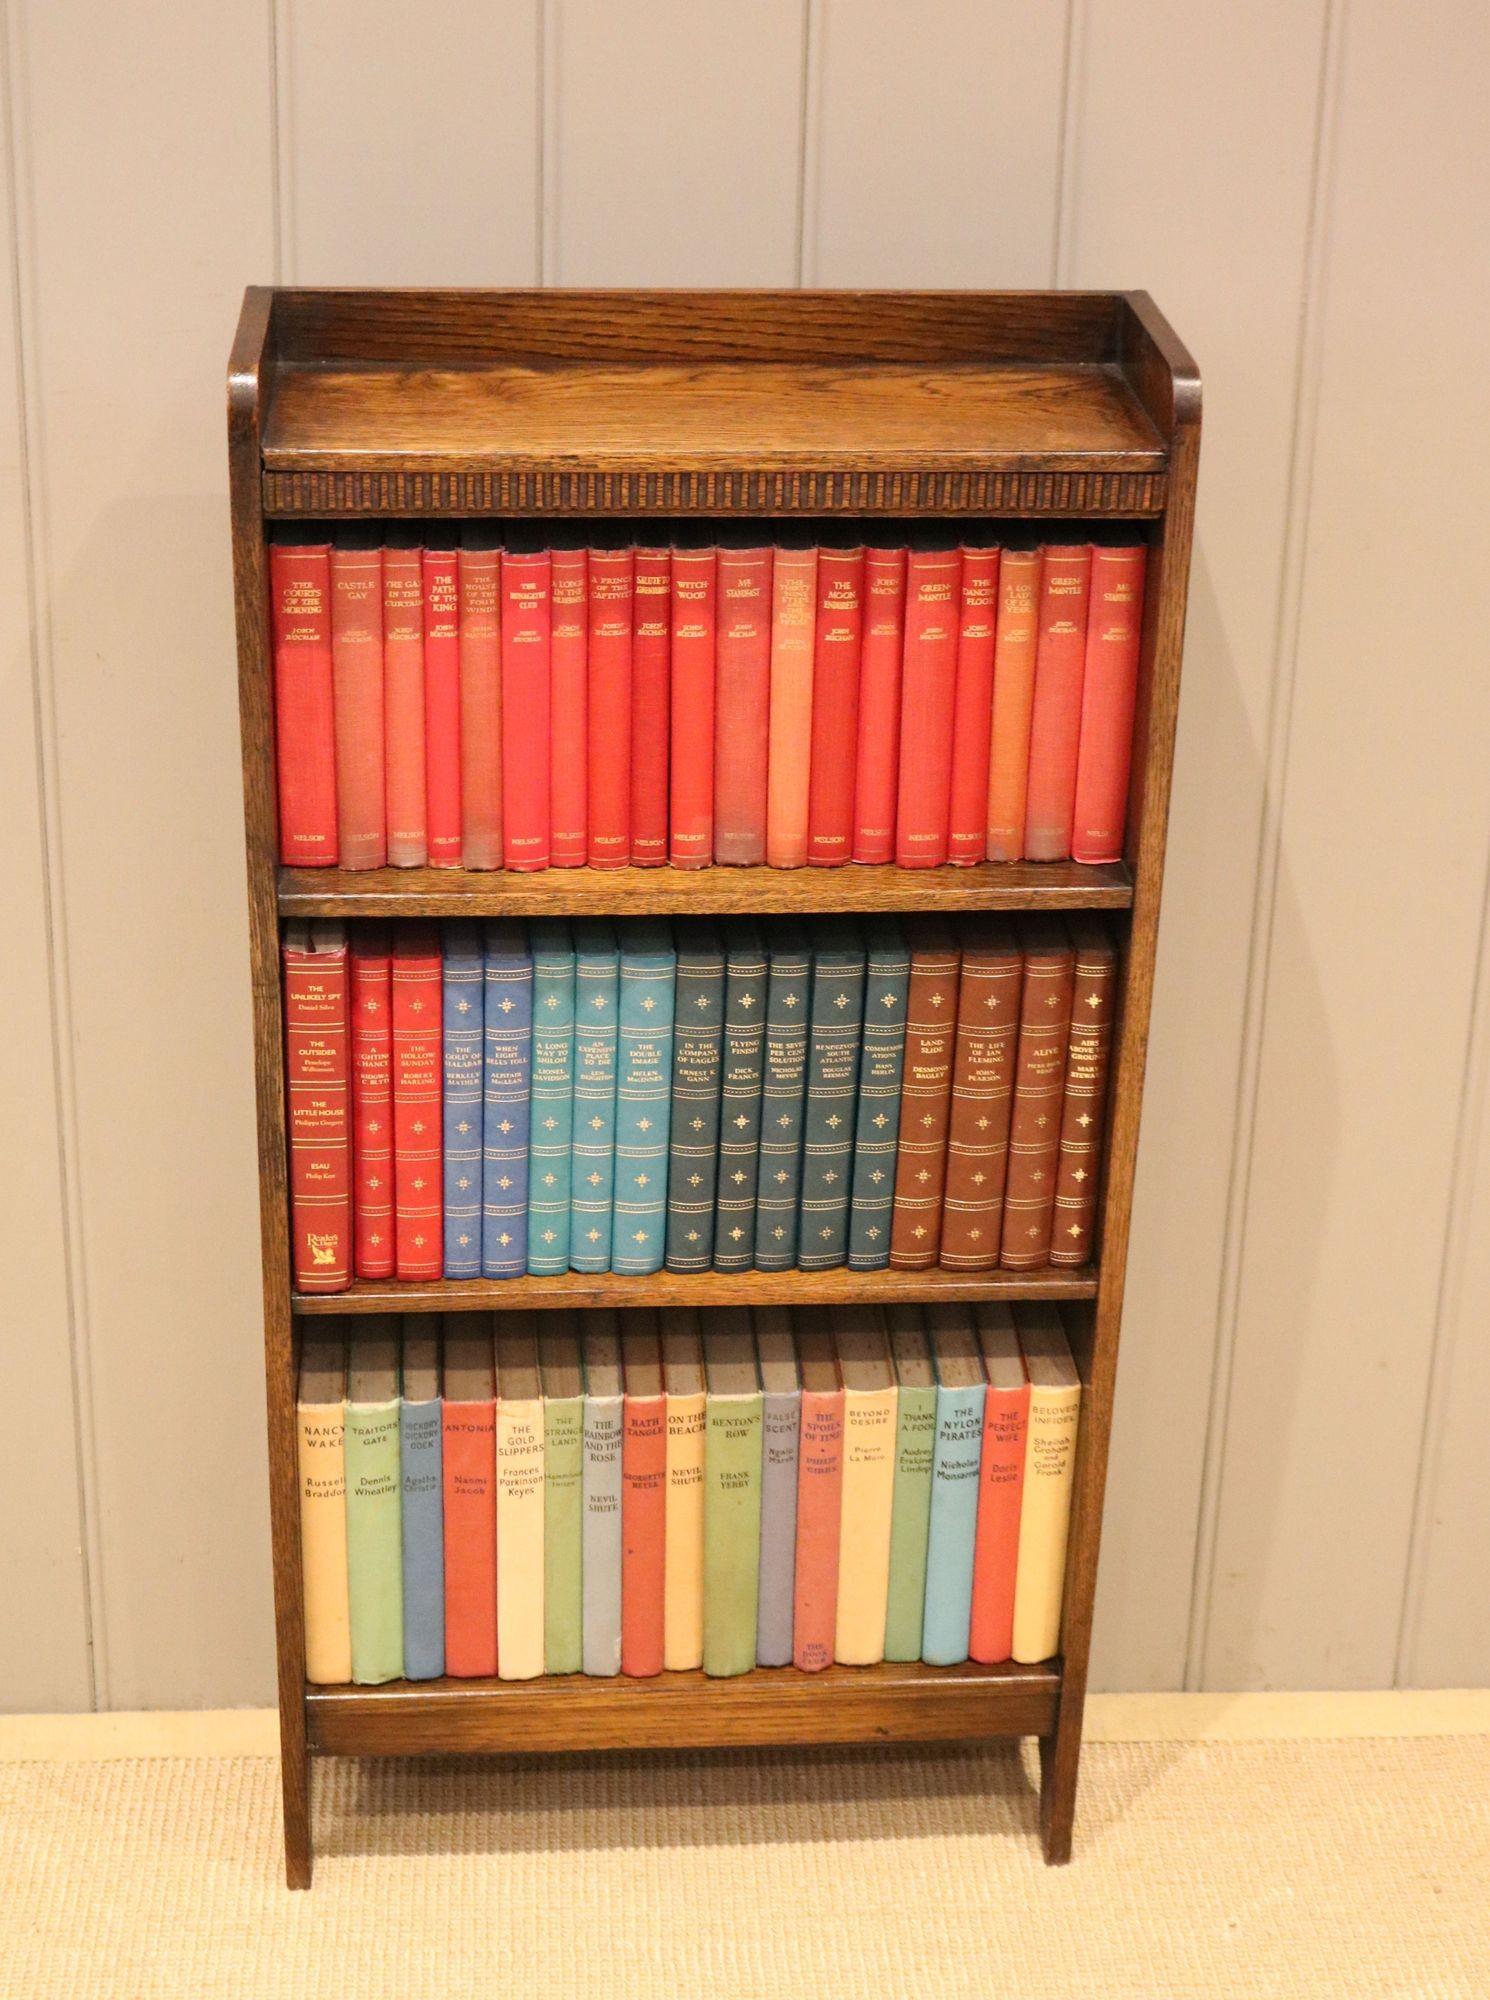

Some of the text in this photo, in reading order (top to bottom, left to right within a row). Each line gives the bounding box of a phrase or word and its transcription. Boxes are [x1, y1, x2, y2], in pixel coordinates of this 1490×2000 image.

[434, 576, 452, 584] THE
[338, 581, 375, 590] CASTLE
[676, 581, 707, 589] WITCH
[429, 594, 441, 602] OF
[676, 591, 706, 599] WOOD
[432, 603, 457, 612] KING
[1033, 1047, 1058, 1057] ALIVE
[850, 1409, 890, 1417] BEYOND
[954, 1408, 973, 1417] THE
[1000, 1411, 1018, 1421] THE
[668, 1411, 706, 1424] ON THE
[851, 1418, 887, 1426] DESIRE
[594, 1421, 613, 1429] THE
[632, 1418, 659, 1427] BATH
[945, 1417, 980, 1429] NYLON
[445, 1425, 494, 1433] ANTONIA
[512, 1426, 530, 1434] THE
[669, 1424, 706, 1435] BEACH
[766, 1423, 798, 1432] SCENT
[726, 1430, 749, 1438] ROW
[805, 1432, 817, 1441] OF
[940, 1429, 982, 1441] PIRATES
[996, 1433, 1019, 1442] WIFE
[307, 1440, 344, 1448] WAKE
[363, 1436, 387, 1446] GATE
[508, 1436, 535, 1445] GOLD
[552, 1439, 577, 1447] LAND
[499, 1445, 544, 1456] SLIPPERS
[585, 1441, 603, 1451] AND
[591, 1453, 616, 1462] ROSE
[941, 1459, 978, 1469] Nicholas
[992, 1463, 1017, 1472] Doris
[504, 1467, 539, 1476] Frances
[672, 1467, 701, 1476] NEVIL
[720, 1471, 750, 1480] FRANK
[360, 1475, 391, 1486] Dennis
[454, 1476, 487, 1485] Naomi
[500, 1475, 543, 1486] Parkinson
[672, 1476, 703, 1486] SHUTE
[721, 1480, 750, 1489] YERBY
[355, 1485, 398, 1496] Wheatley
[454, 1486, 485, 1495] Jacob
[509, 1487, 534, 1498] Keyes
[589, 1504, 618, 1513] SHUTE
